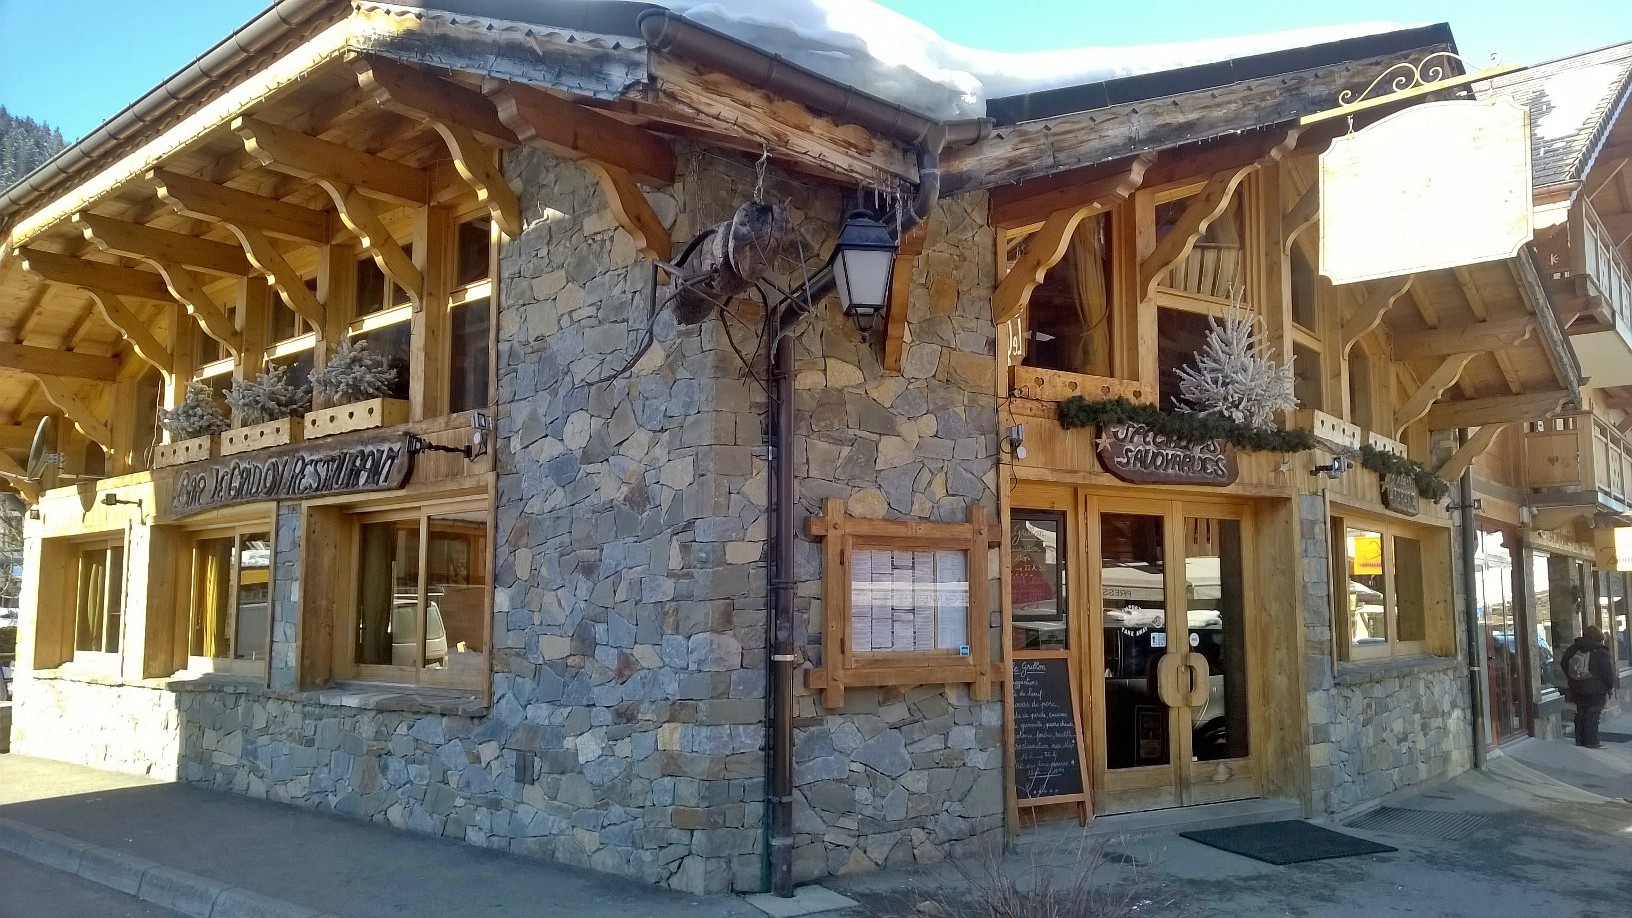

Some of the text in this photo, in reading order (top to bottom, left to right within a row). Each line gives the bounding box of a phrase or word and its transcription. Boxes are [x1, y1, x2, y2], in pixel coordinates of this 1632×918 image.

[1114, 446, 1228, 480] SAVOYARDES
[173, 471, 207, 509] BAR
[1021, 661, 1046, 677] Grillon
